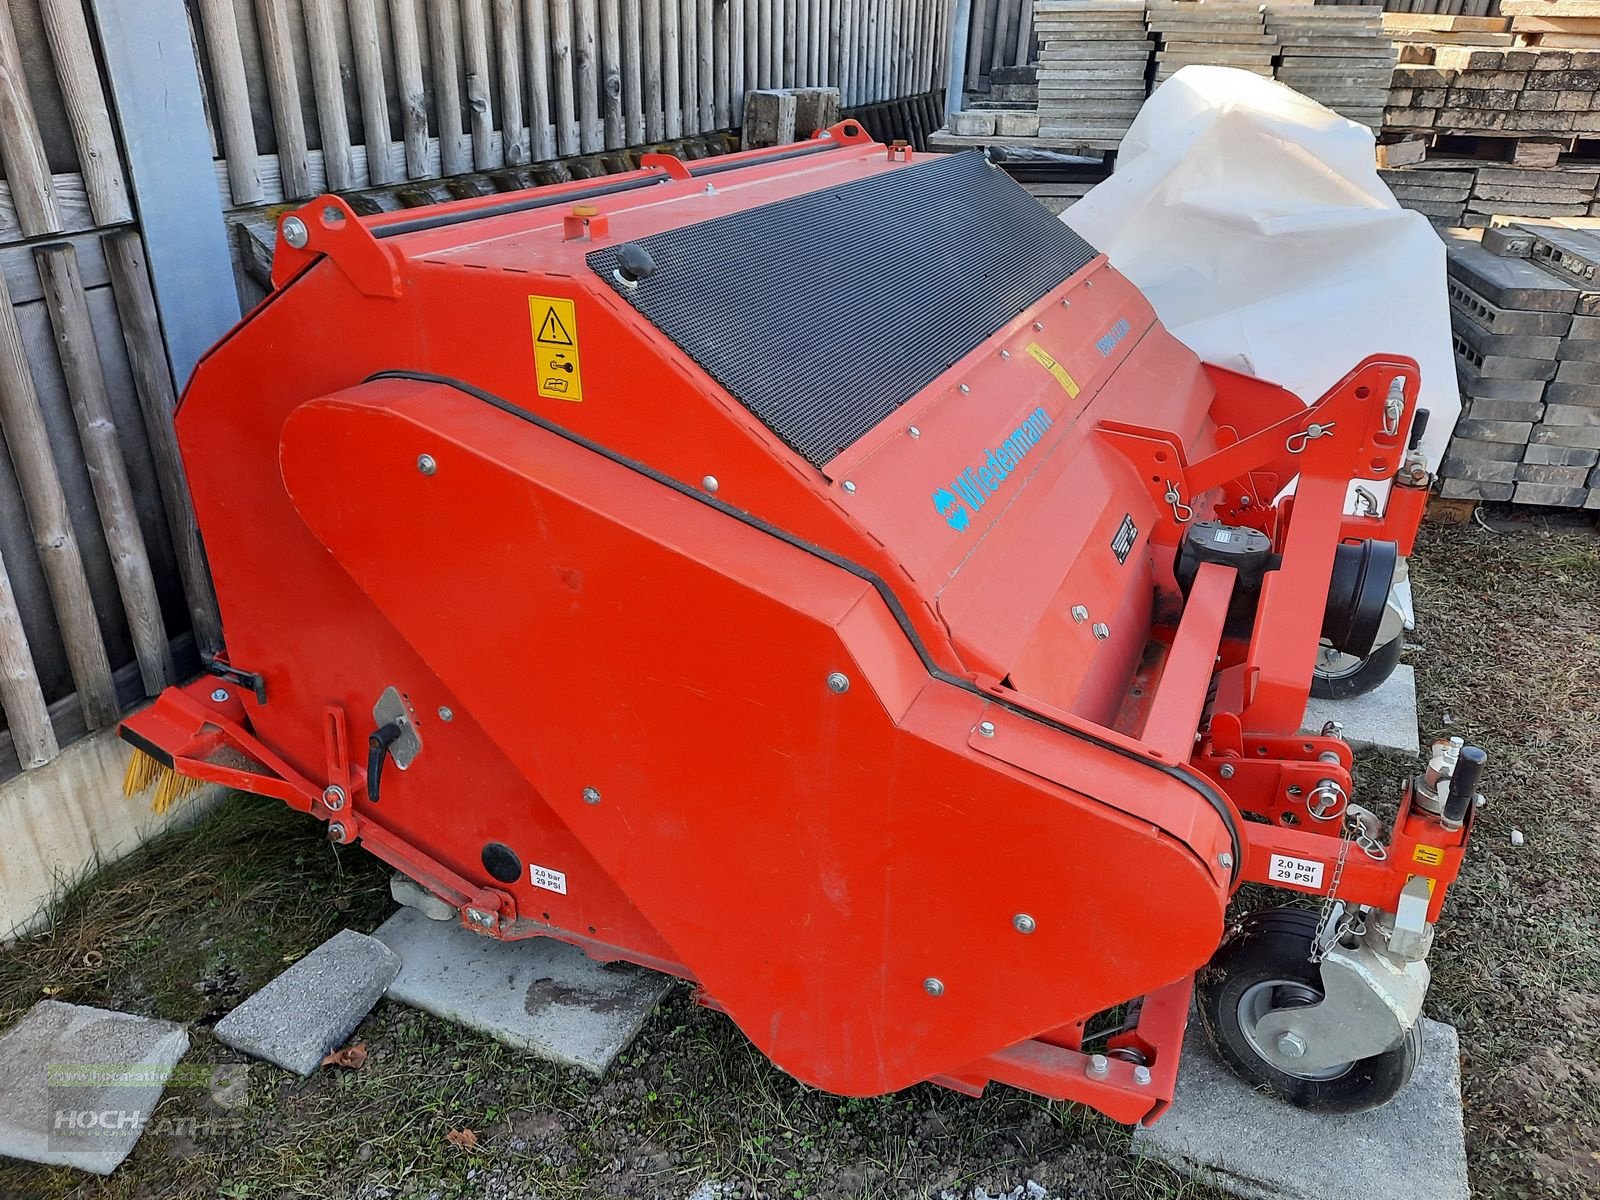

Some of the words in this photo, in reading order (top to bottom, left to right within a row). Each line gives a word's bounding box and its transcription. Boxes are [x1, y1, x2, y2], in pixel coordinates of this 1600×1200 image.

[950, 407, 1054, 512] Wiedenmann
[1277, 859, 1294, 869] 2,0
[1297, 862, 1317, 873] bar
[548, 872, 560, 881] bar
[1277, 869, 1291, 879] 29
[1294, 872, 1314, 883] PSI
[548, 880, 560, 890] PSI
